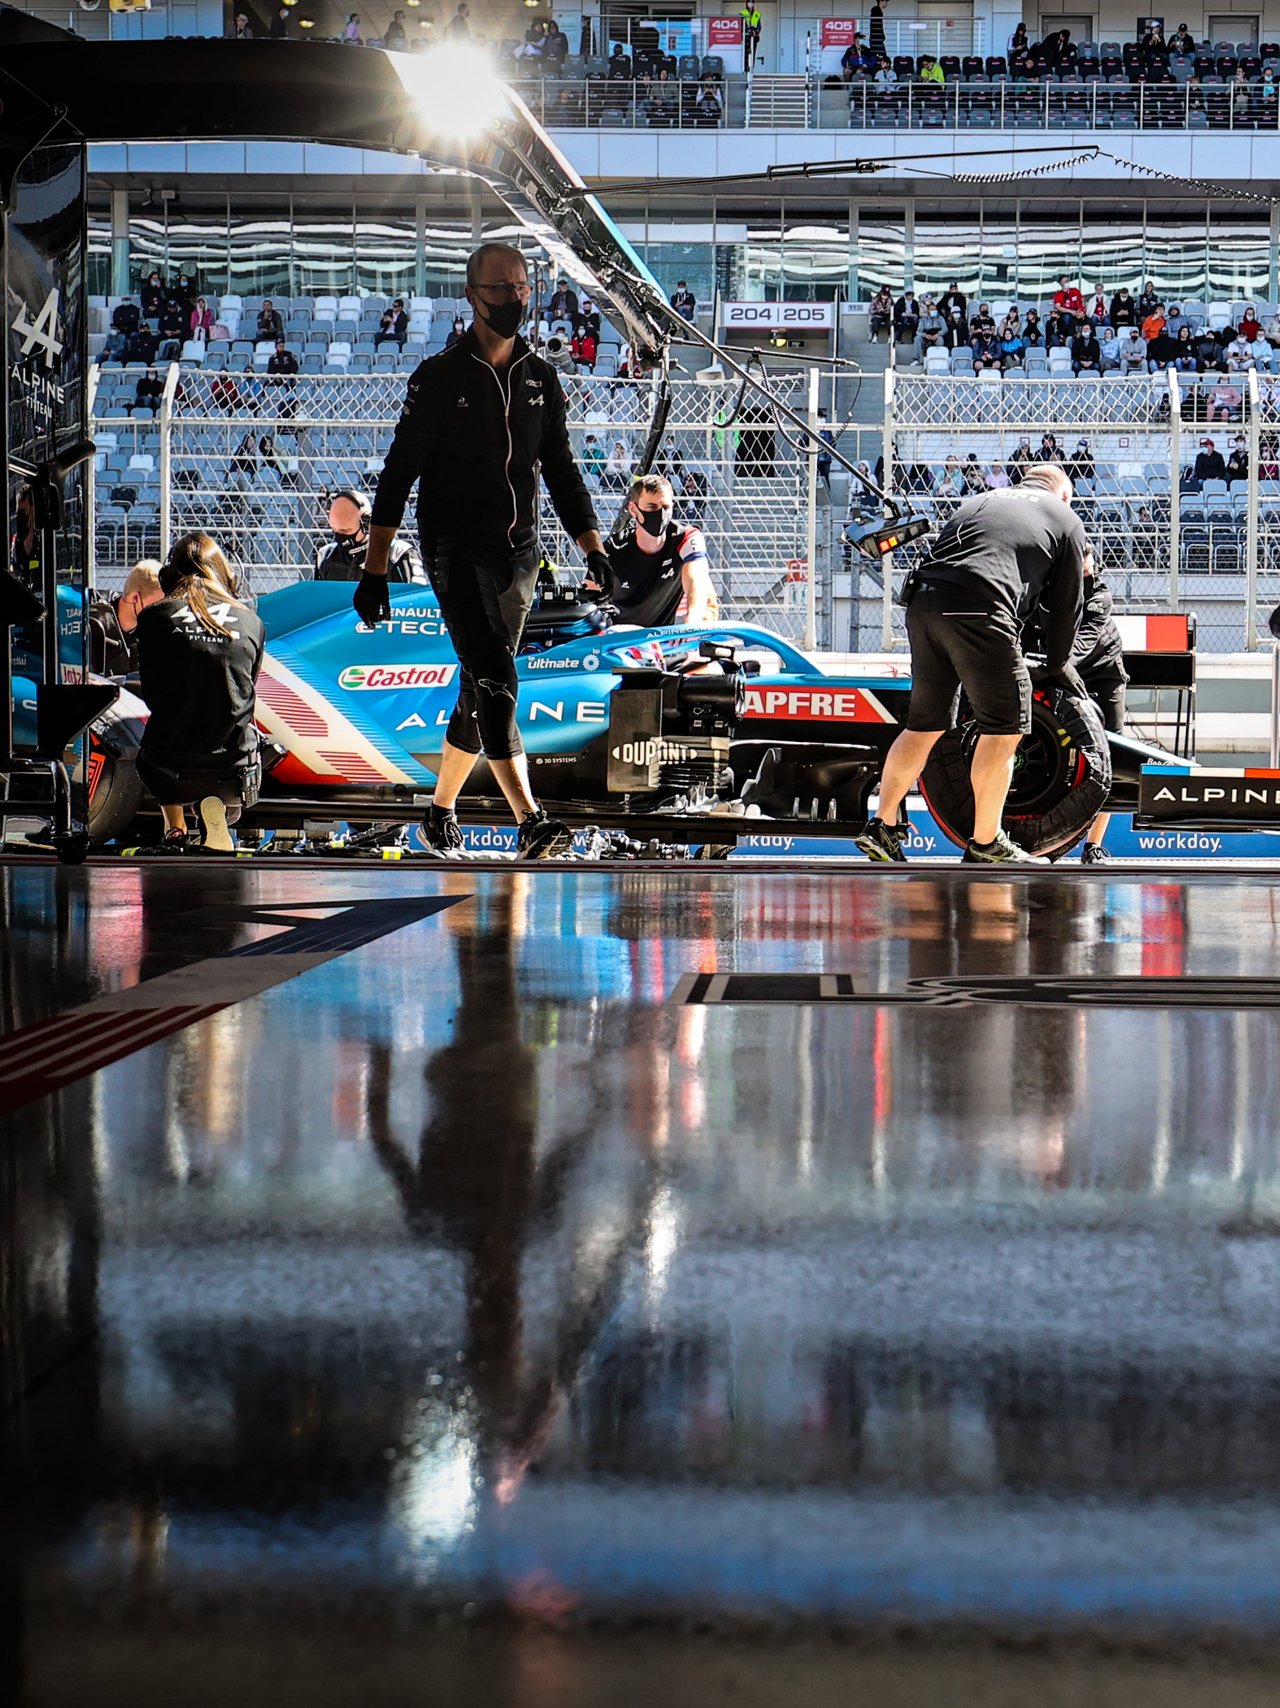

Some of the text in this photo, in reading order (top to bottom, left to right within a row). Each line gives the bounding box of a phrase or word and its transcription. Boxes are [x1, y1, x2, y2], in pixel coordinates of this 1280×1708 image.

[712, 20, 739, 29] 404
[825, 21, 852, 31] 405
[730, 308, 825, 321] 204 205
[11, 364, 65, 405] ALPINE
[379, 607, 441, 618] ENAULT
[172, 626, 240, 640] ALP
[528, 659, 579, 669] ultimate
[366, 667, 447, 687] Castrol
[744, 690, 856, 717] APFRE
[395, 701, 606, 731] ALNE
[622, 741, 689, 766] DUPONT
[462, 831, 516, 850] rkday.
[1138, 832, 1223, 853] workday.
